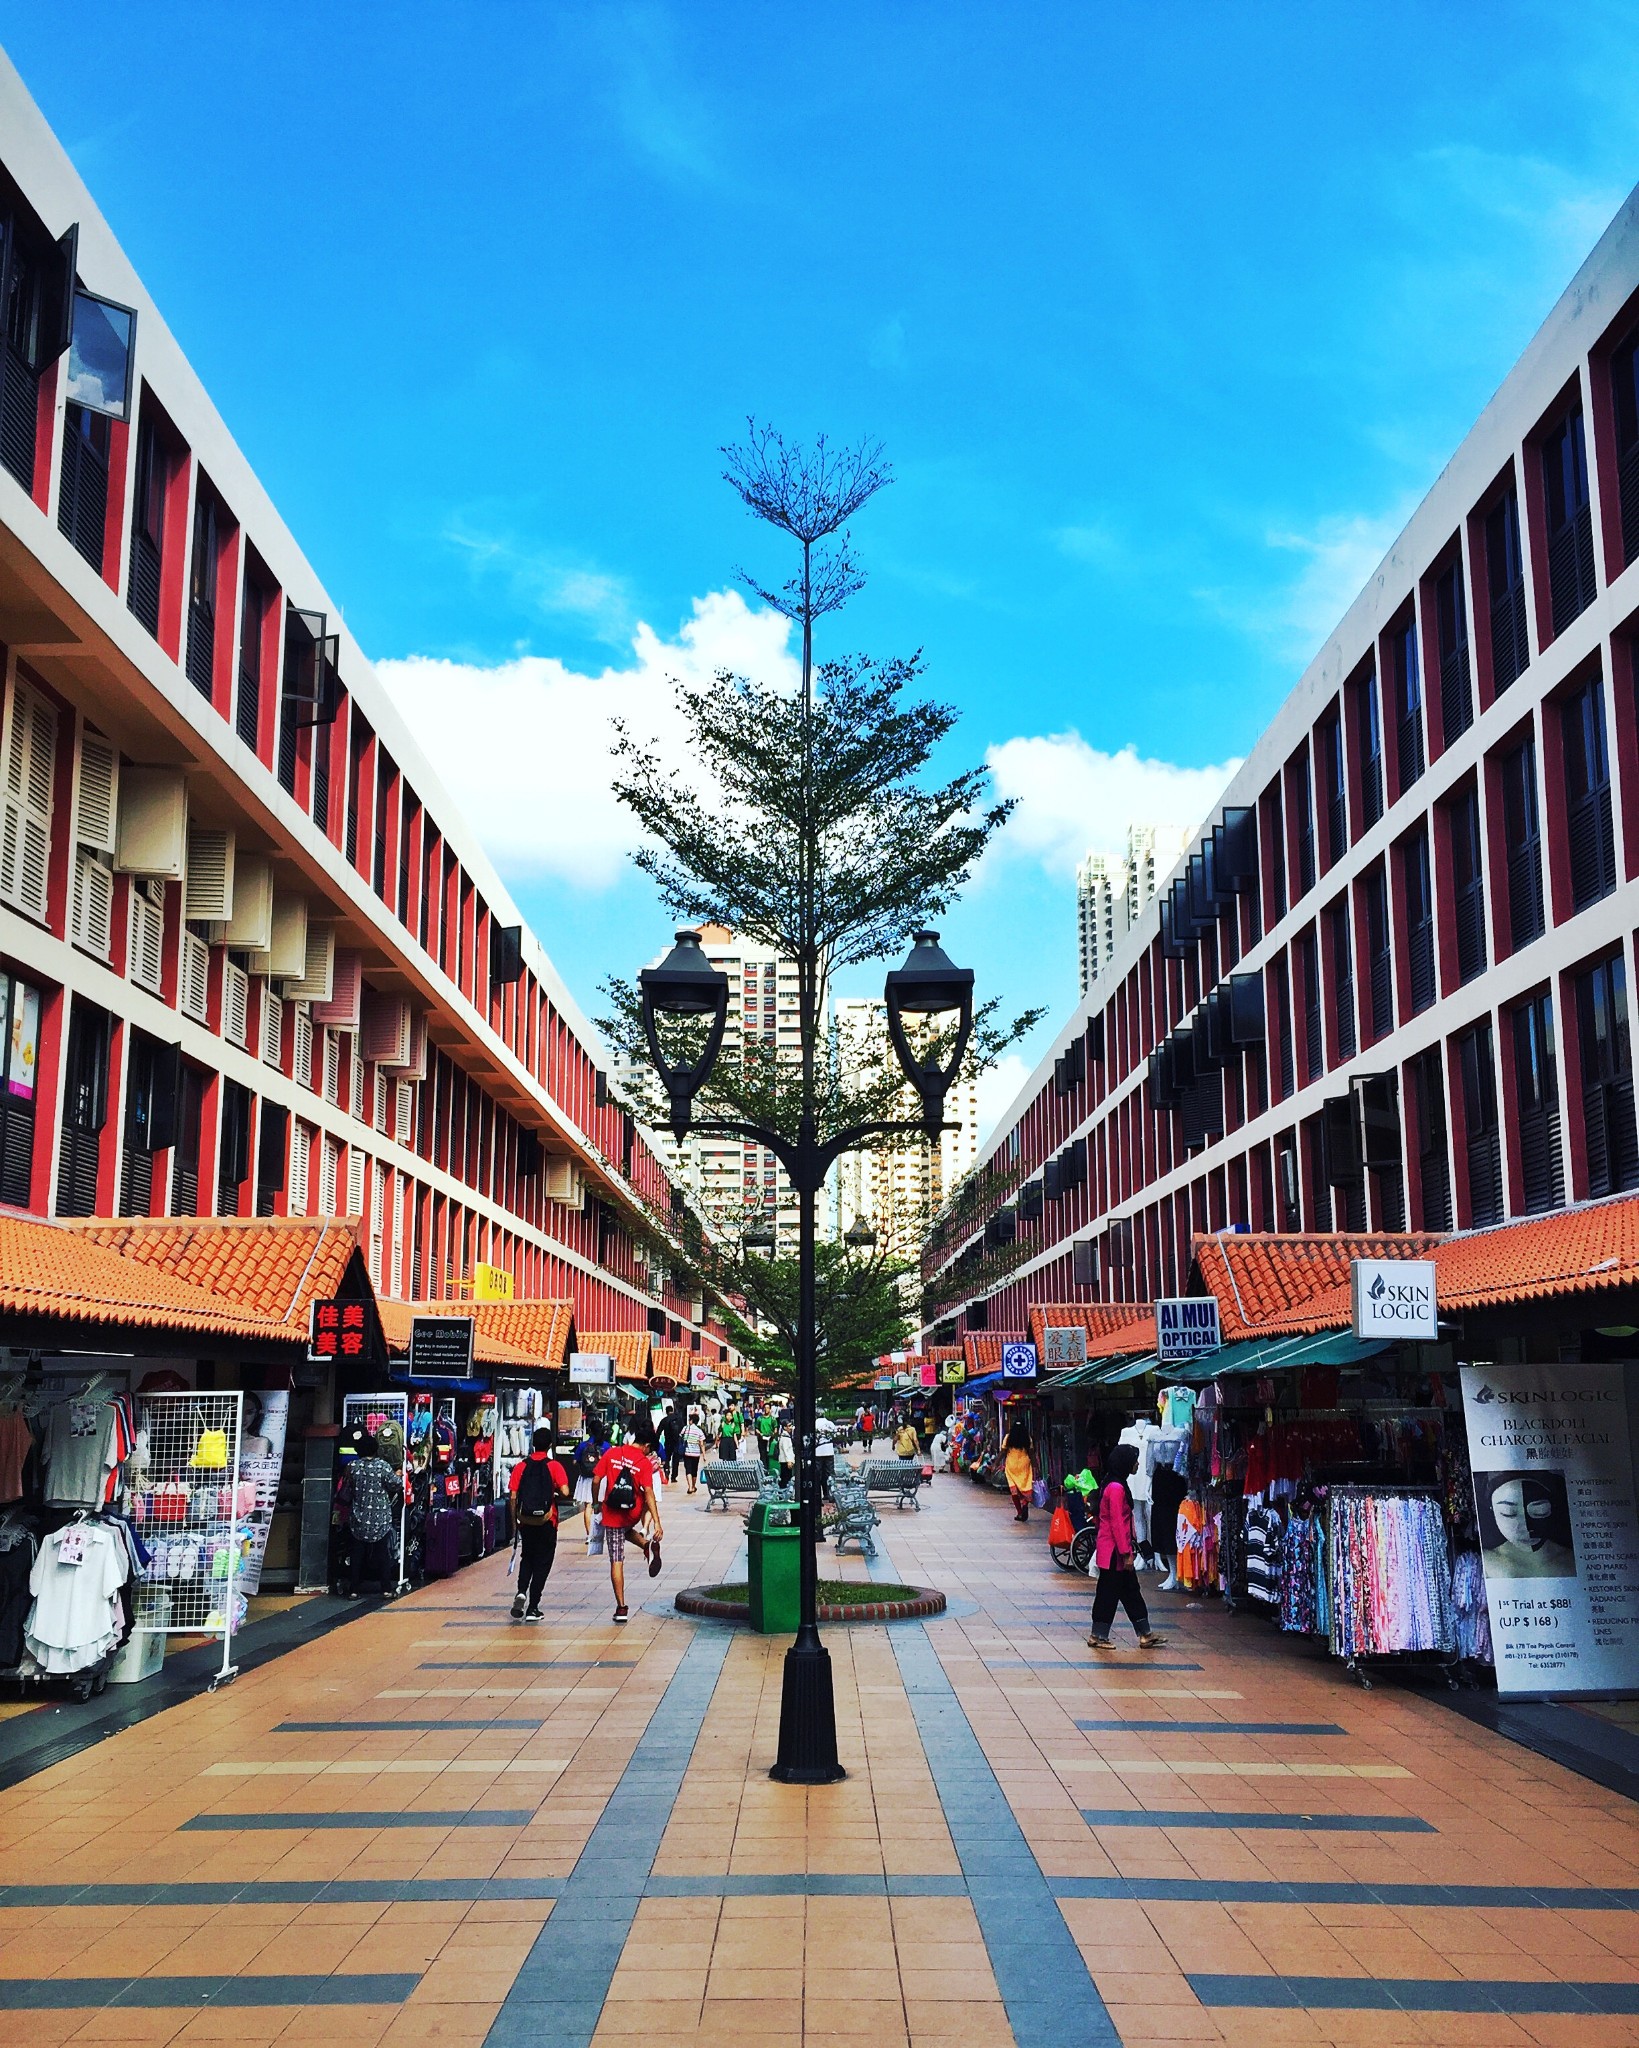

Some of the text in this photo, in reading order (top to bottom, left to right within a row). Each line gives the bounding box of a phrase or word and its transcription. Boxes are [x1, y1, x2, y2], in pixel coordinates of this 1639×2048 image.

[1387, 1285, 1429, 1303] SKIN
[317, 1305, 364, 1328] 佳美
[1161, 1303, 1216, 1329] AI MUI
[1372, 1303, 1429, 1320] LOGIC
[435, 1329, 469, 1339] Mobile
[1162, 1331, 1217, 1347] OPTICAL
[316, 1332, 363, 1355] 美容
[1497, 1389, 1618, 1404] SKINLOGIC
[1480, 1433, 1614, 1447] CHARCOAL FACIAL
[1512, 1599, 1534, 1609] Trial
[1537, 1601, 1547, 1609] at
[1550, 1598, 1572, 1610] $88!
[1523, 1616, 1530, 1628] $
[1534, 1616, 1551, 1626] 168
[1538, 1642, 1554, 1650] Payoh
[1528, 1652, 1554, 1660] Singapore
